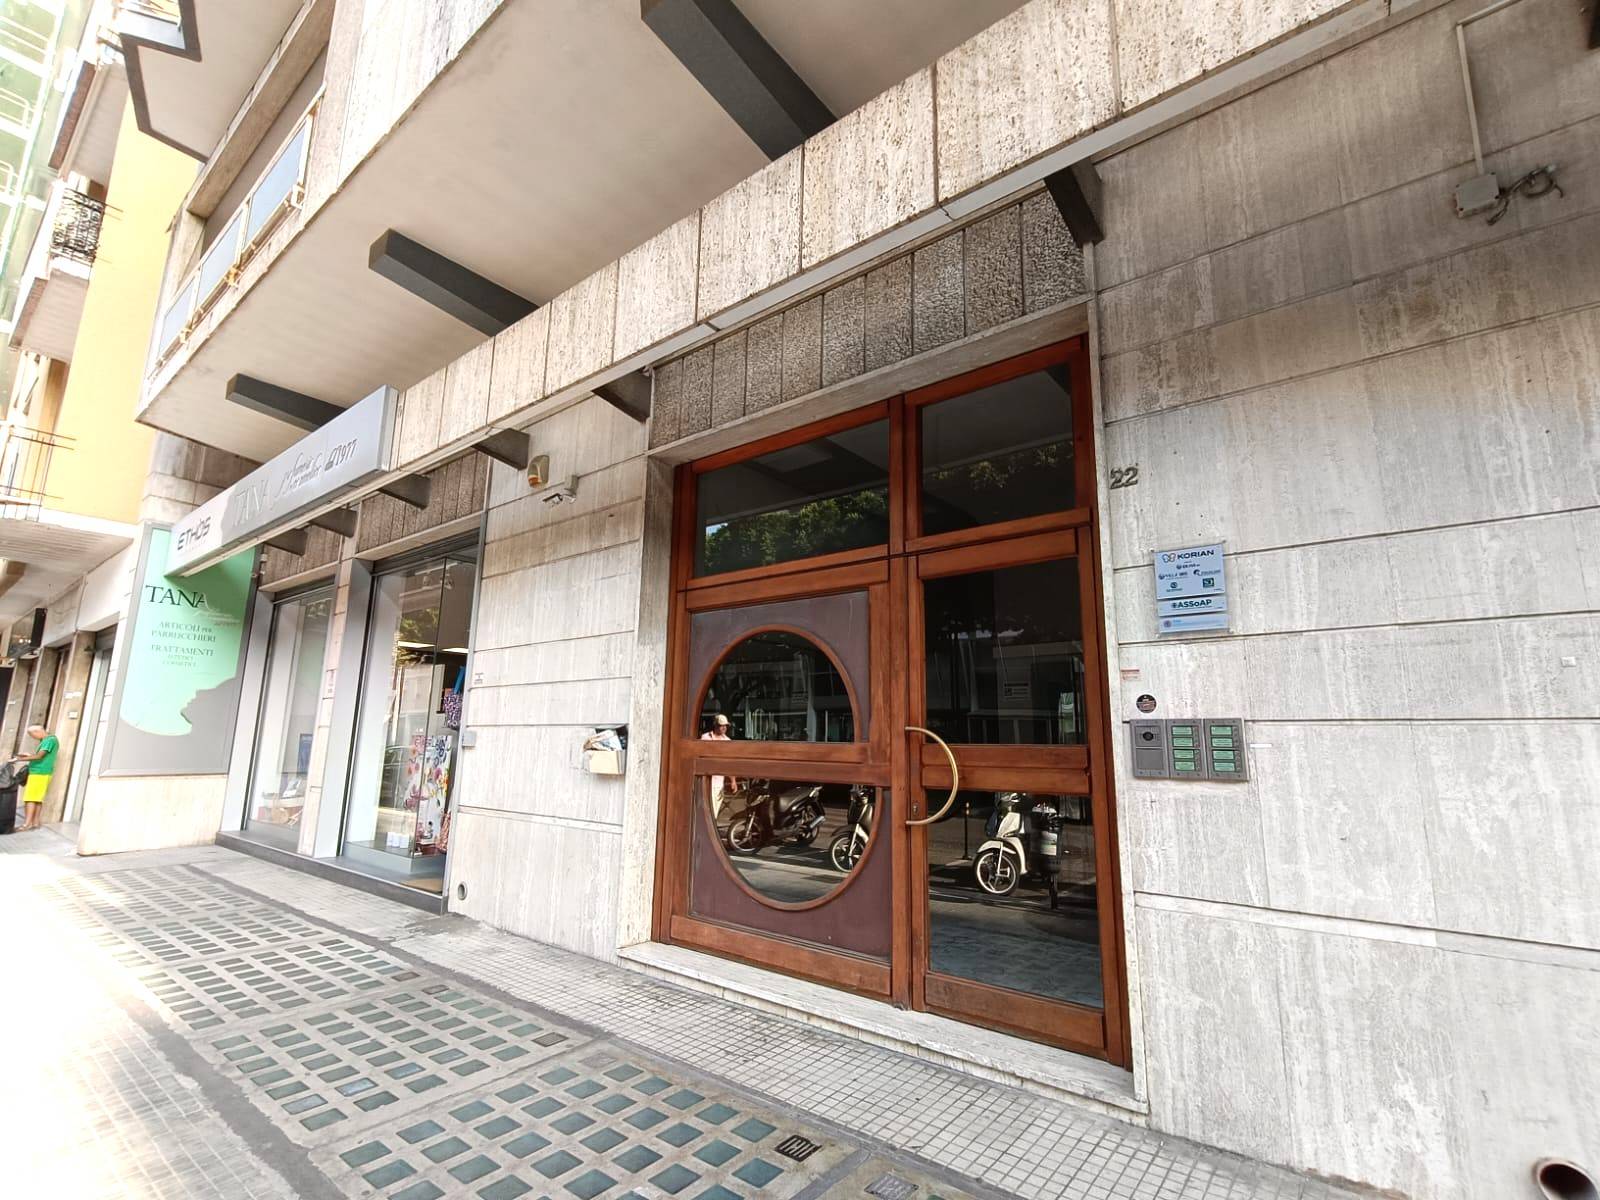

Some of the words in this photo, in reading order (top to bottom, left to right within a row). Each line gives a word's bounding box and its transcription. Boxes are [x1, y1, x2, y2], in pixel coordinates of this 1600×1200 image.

[1109, 466, 1138, 489] 22
[1177, 549, 1214, 560] KORIAN
[145, 584, 209, 610] TANA
[160, 620, 201, 633] ARTICOLI
[151, 629, 217, 643] PARRUCCHIERI
[151, 643, 215, 657] TRATTAMENTI
